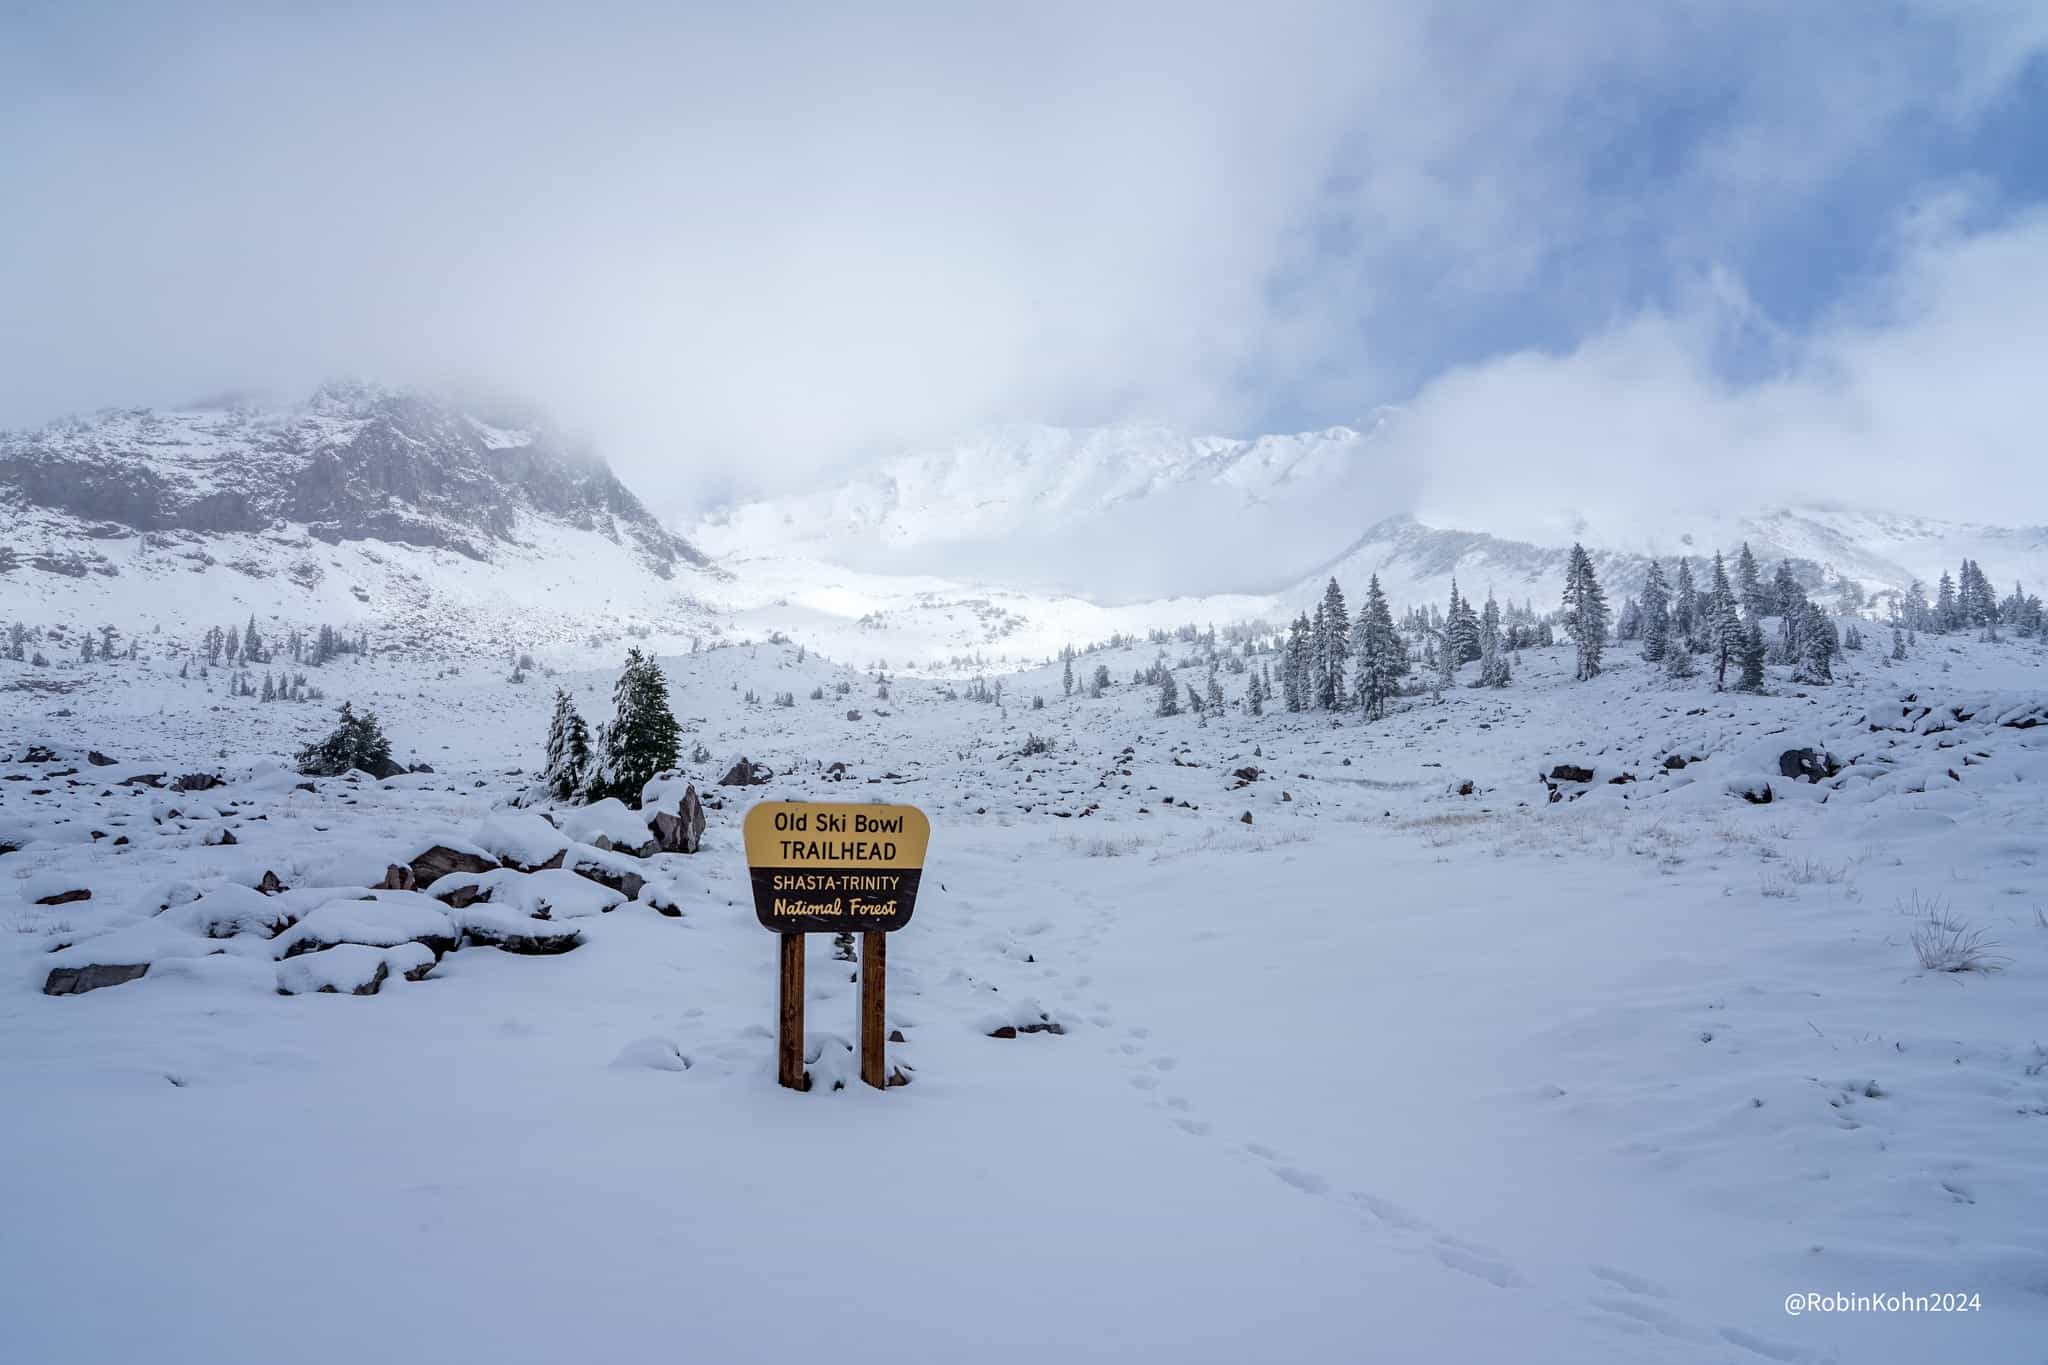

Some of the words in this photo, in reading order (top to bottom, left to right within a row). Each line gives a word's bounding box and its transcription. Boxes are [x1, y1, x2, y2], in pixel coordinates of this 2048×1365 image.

[774, 812, 807, 832] Old
[816, 813, 846, 833] Ski
[855, 814, 903, 833] Bowl
[780, 841, 897, 861] TRAILHEAD
[773, 875, 900, 891] SHASTA-TRINITY
[773, 898, 842, 917] National
[849, 898, 897, 916] Forest
